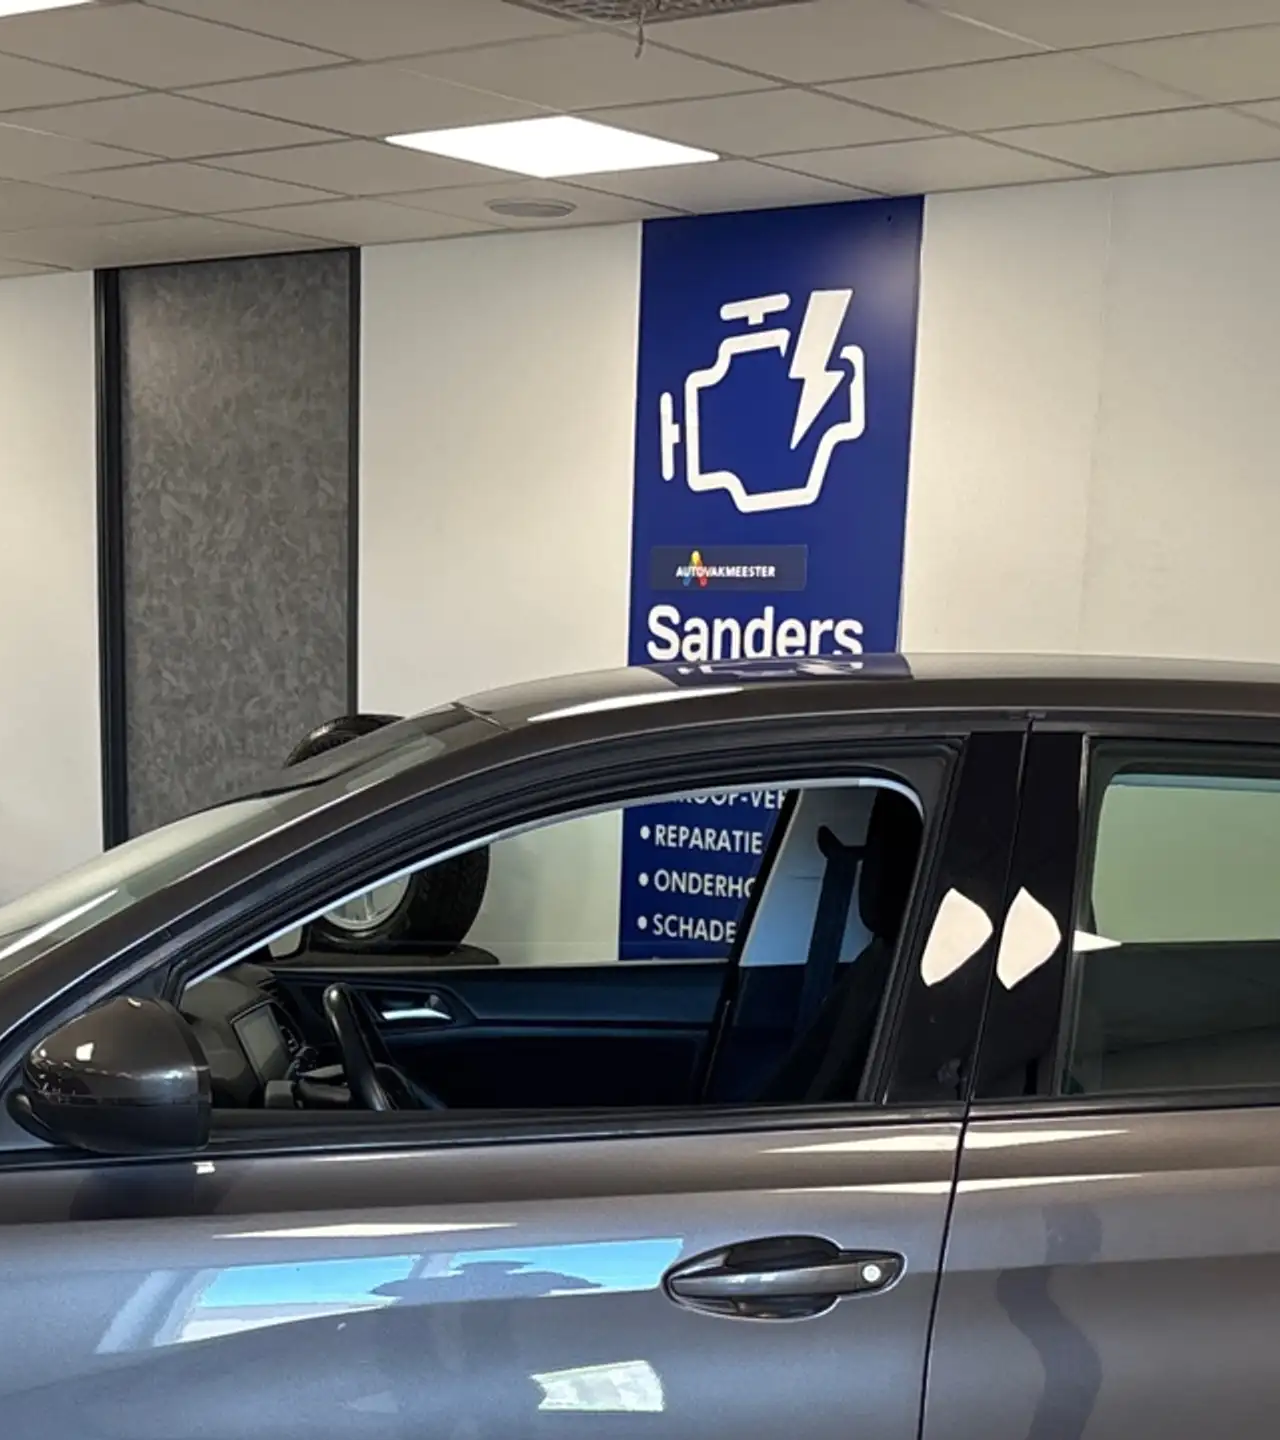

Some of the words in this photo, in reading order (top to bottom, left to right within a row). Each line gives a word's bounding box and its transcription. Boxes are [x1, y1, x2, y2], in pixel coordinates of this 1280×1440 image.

[675, 565, 776, 578] AUTOVAKMEESTER
[646, 604, 863, 661] Sanders
[654, 824, 763, 854] REPARATIE
[652, 912, 738, 944] SCHADE
